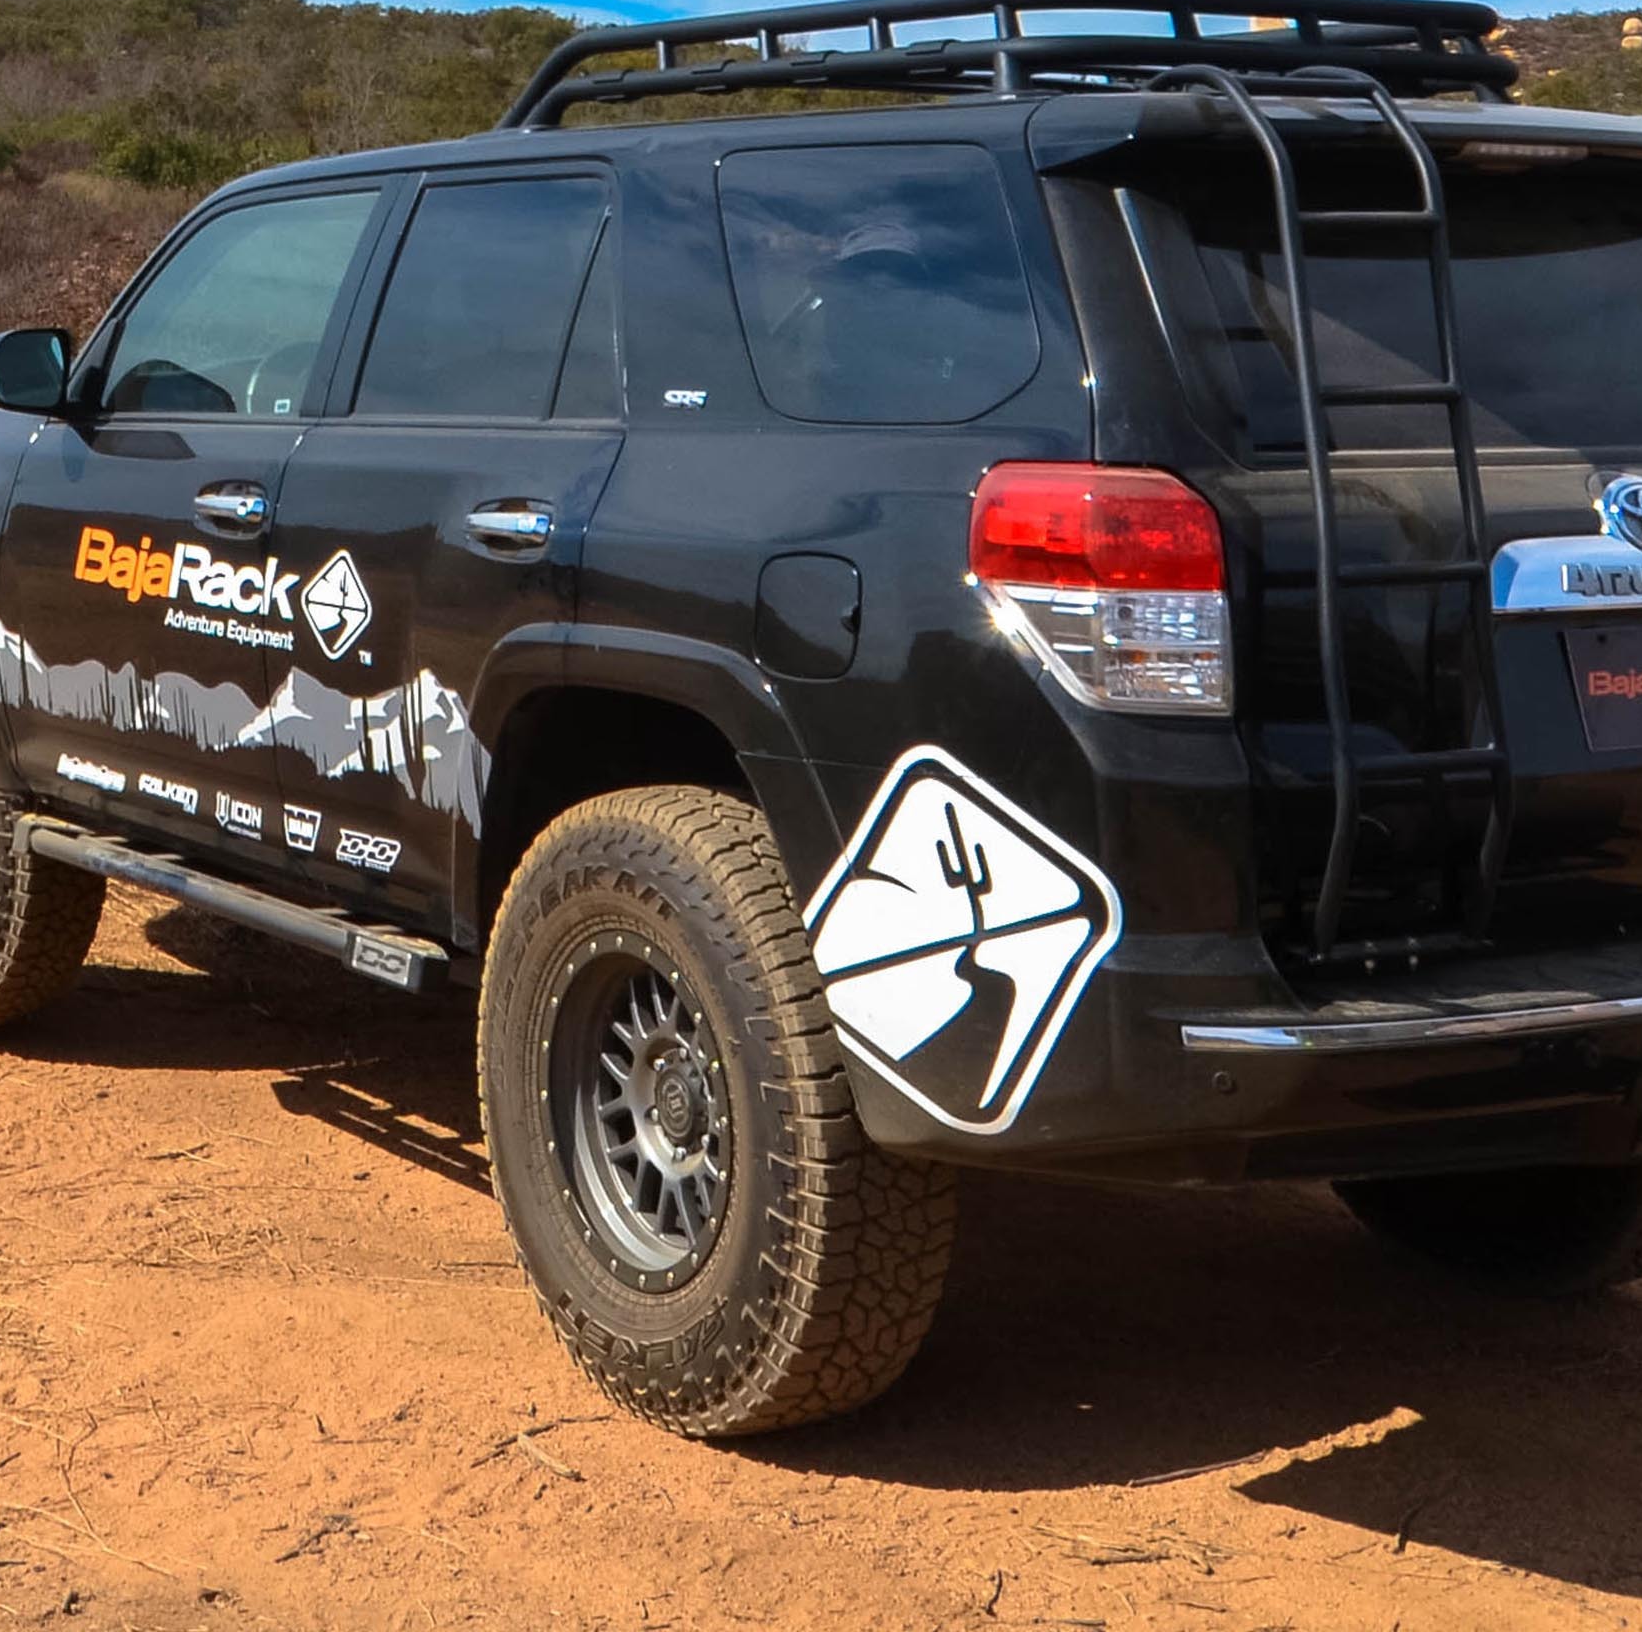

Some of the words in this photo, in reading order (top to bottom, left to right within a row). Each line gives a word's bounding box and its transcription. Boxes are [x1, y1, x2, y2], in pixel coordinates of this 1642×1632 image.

[74, 525, 301, 621] BajaRack
[164, 608, 225, 638] Adventure
[227, 619, 294, 652] Equipment
[230, 799, 263, 829] ICON
